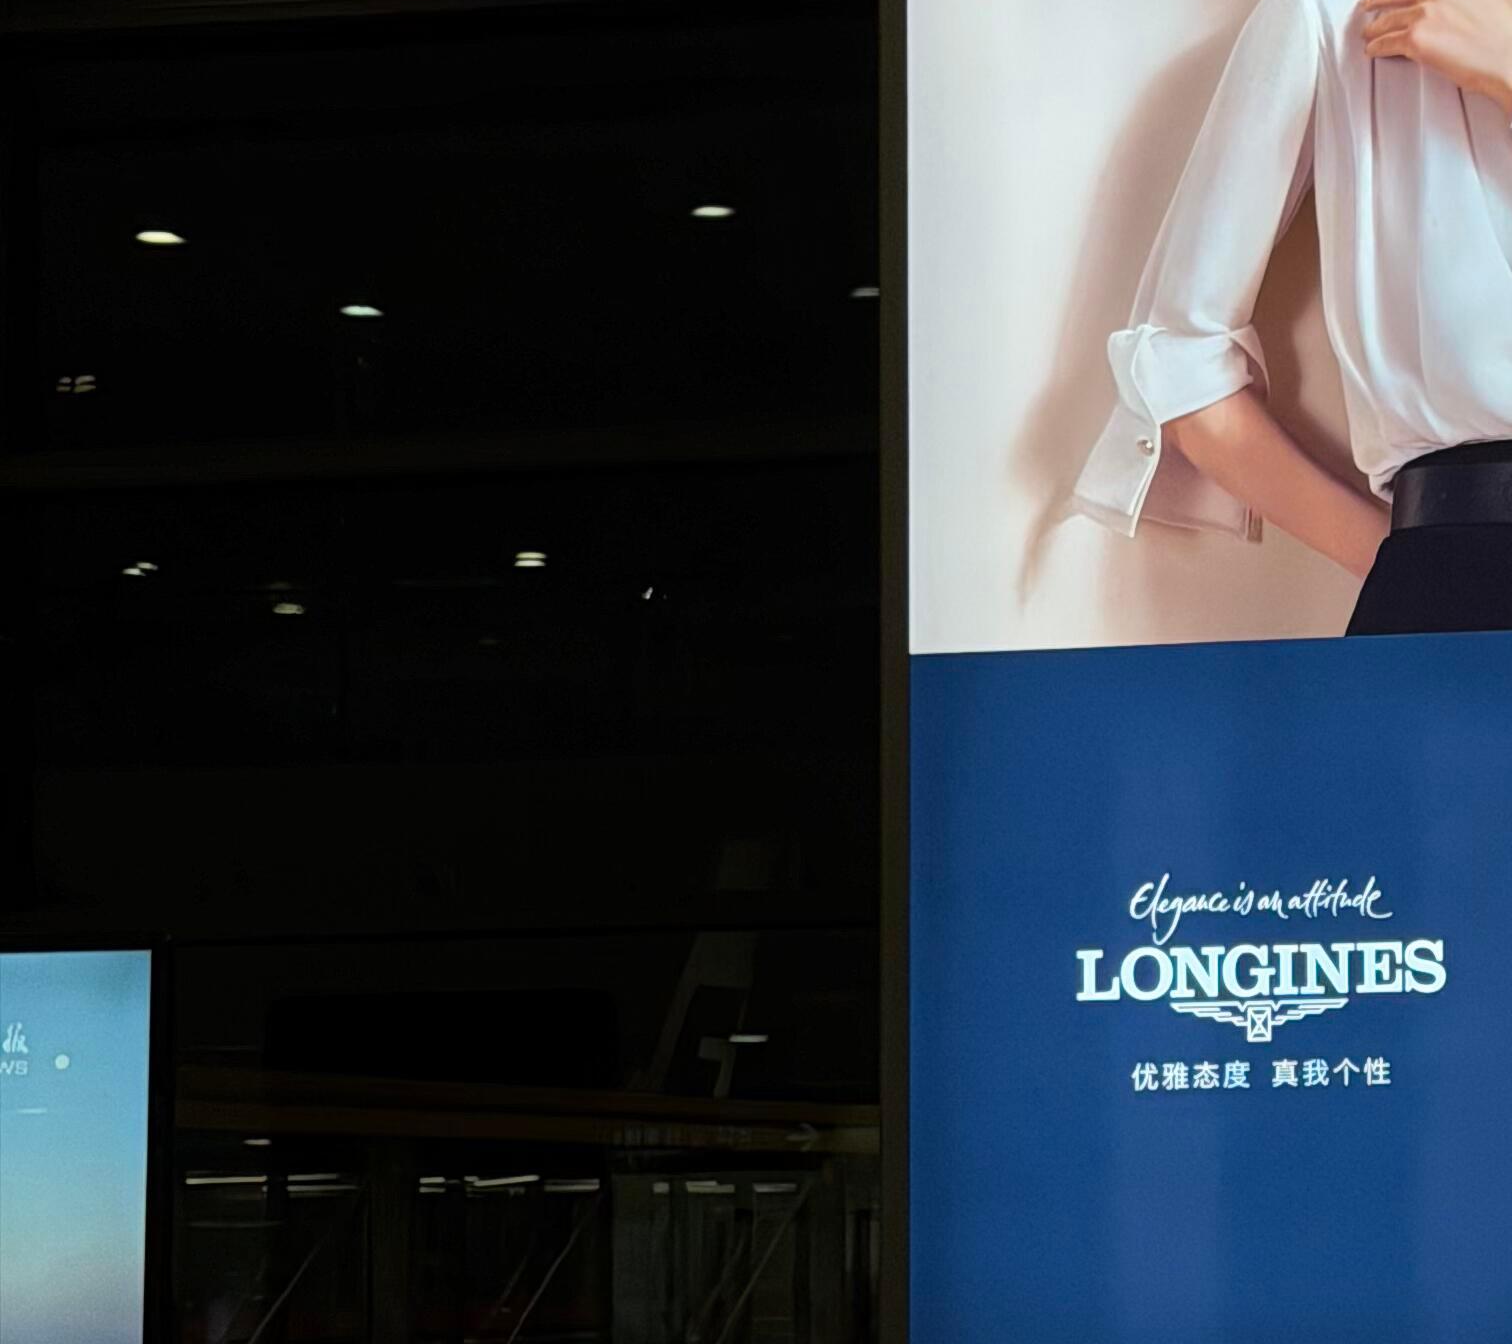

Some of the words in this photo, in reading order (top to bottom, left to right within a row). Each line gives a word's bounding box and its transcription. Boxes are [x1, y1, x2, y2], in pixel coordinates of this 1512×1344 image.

[1129, 872, 1230, 945] Elegance
[1231, 881, 1255, 916] is
[1256, 890, 1289, 920] an
[1288, 875, 1393, 920] attitude
[1075, 939, 1447, 1002] LONGINES
[1131, 1060, 1251, 1092] 优雅态度
[1271, 1056, 1392, 1089] 真我个性
